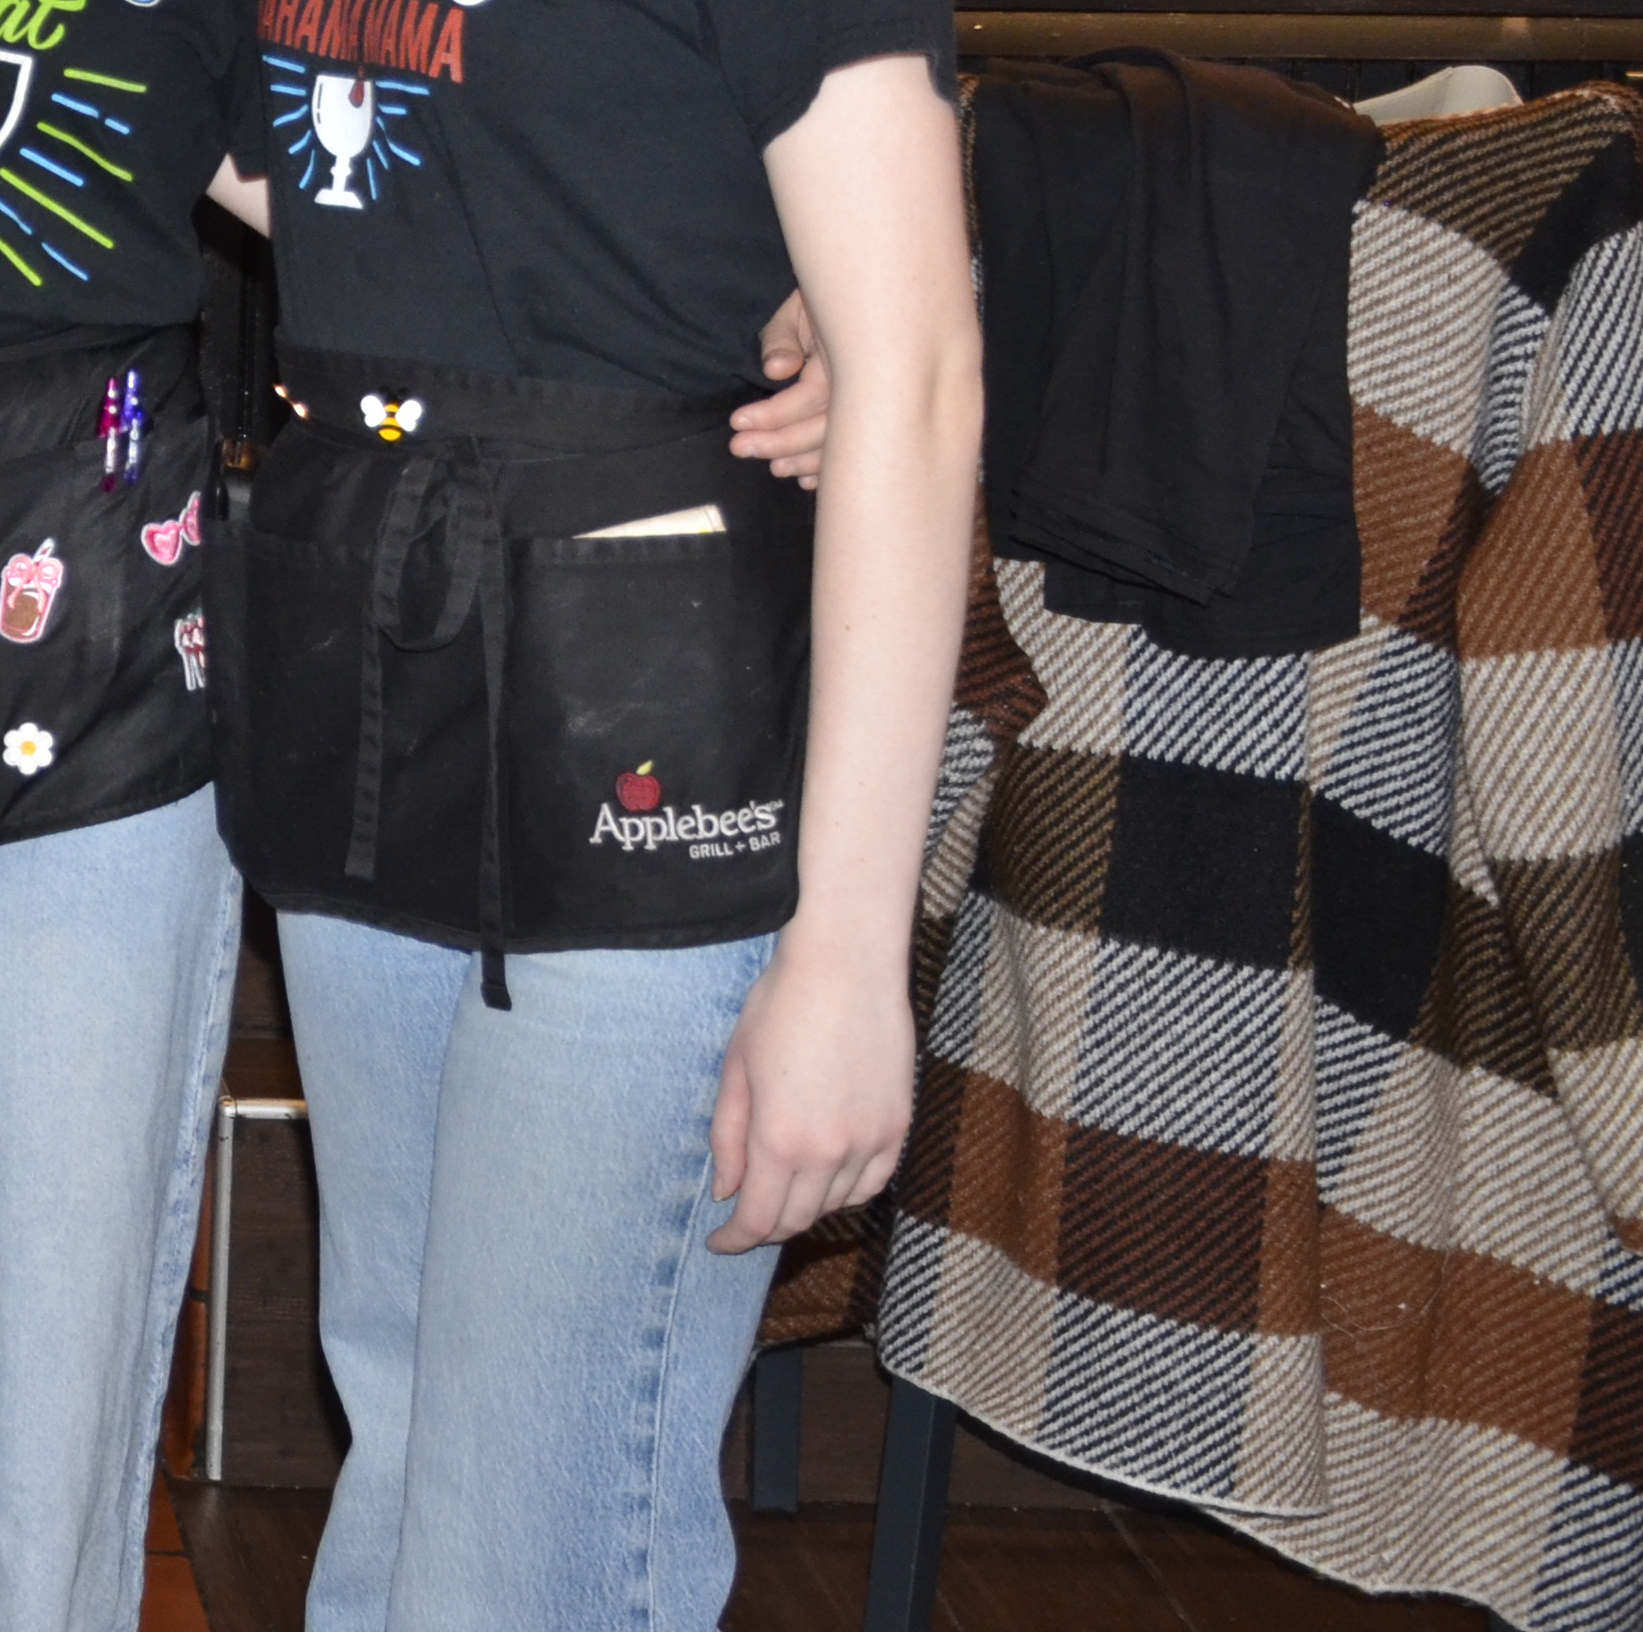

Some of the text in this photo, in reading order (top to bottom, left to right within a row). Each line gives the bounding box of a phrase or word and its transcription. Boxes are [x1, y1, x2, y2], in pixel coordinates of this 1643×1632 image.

[588, 800, 779, 852] Applebee's
[688, 841, 735, 860] GRILL
[749, 831, 782, 853] BAR
